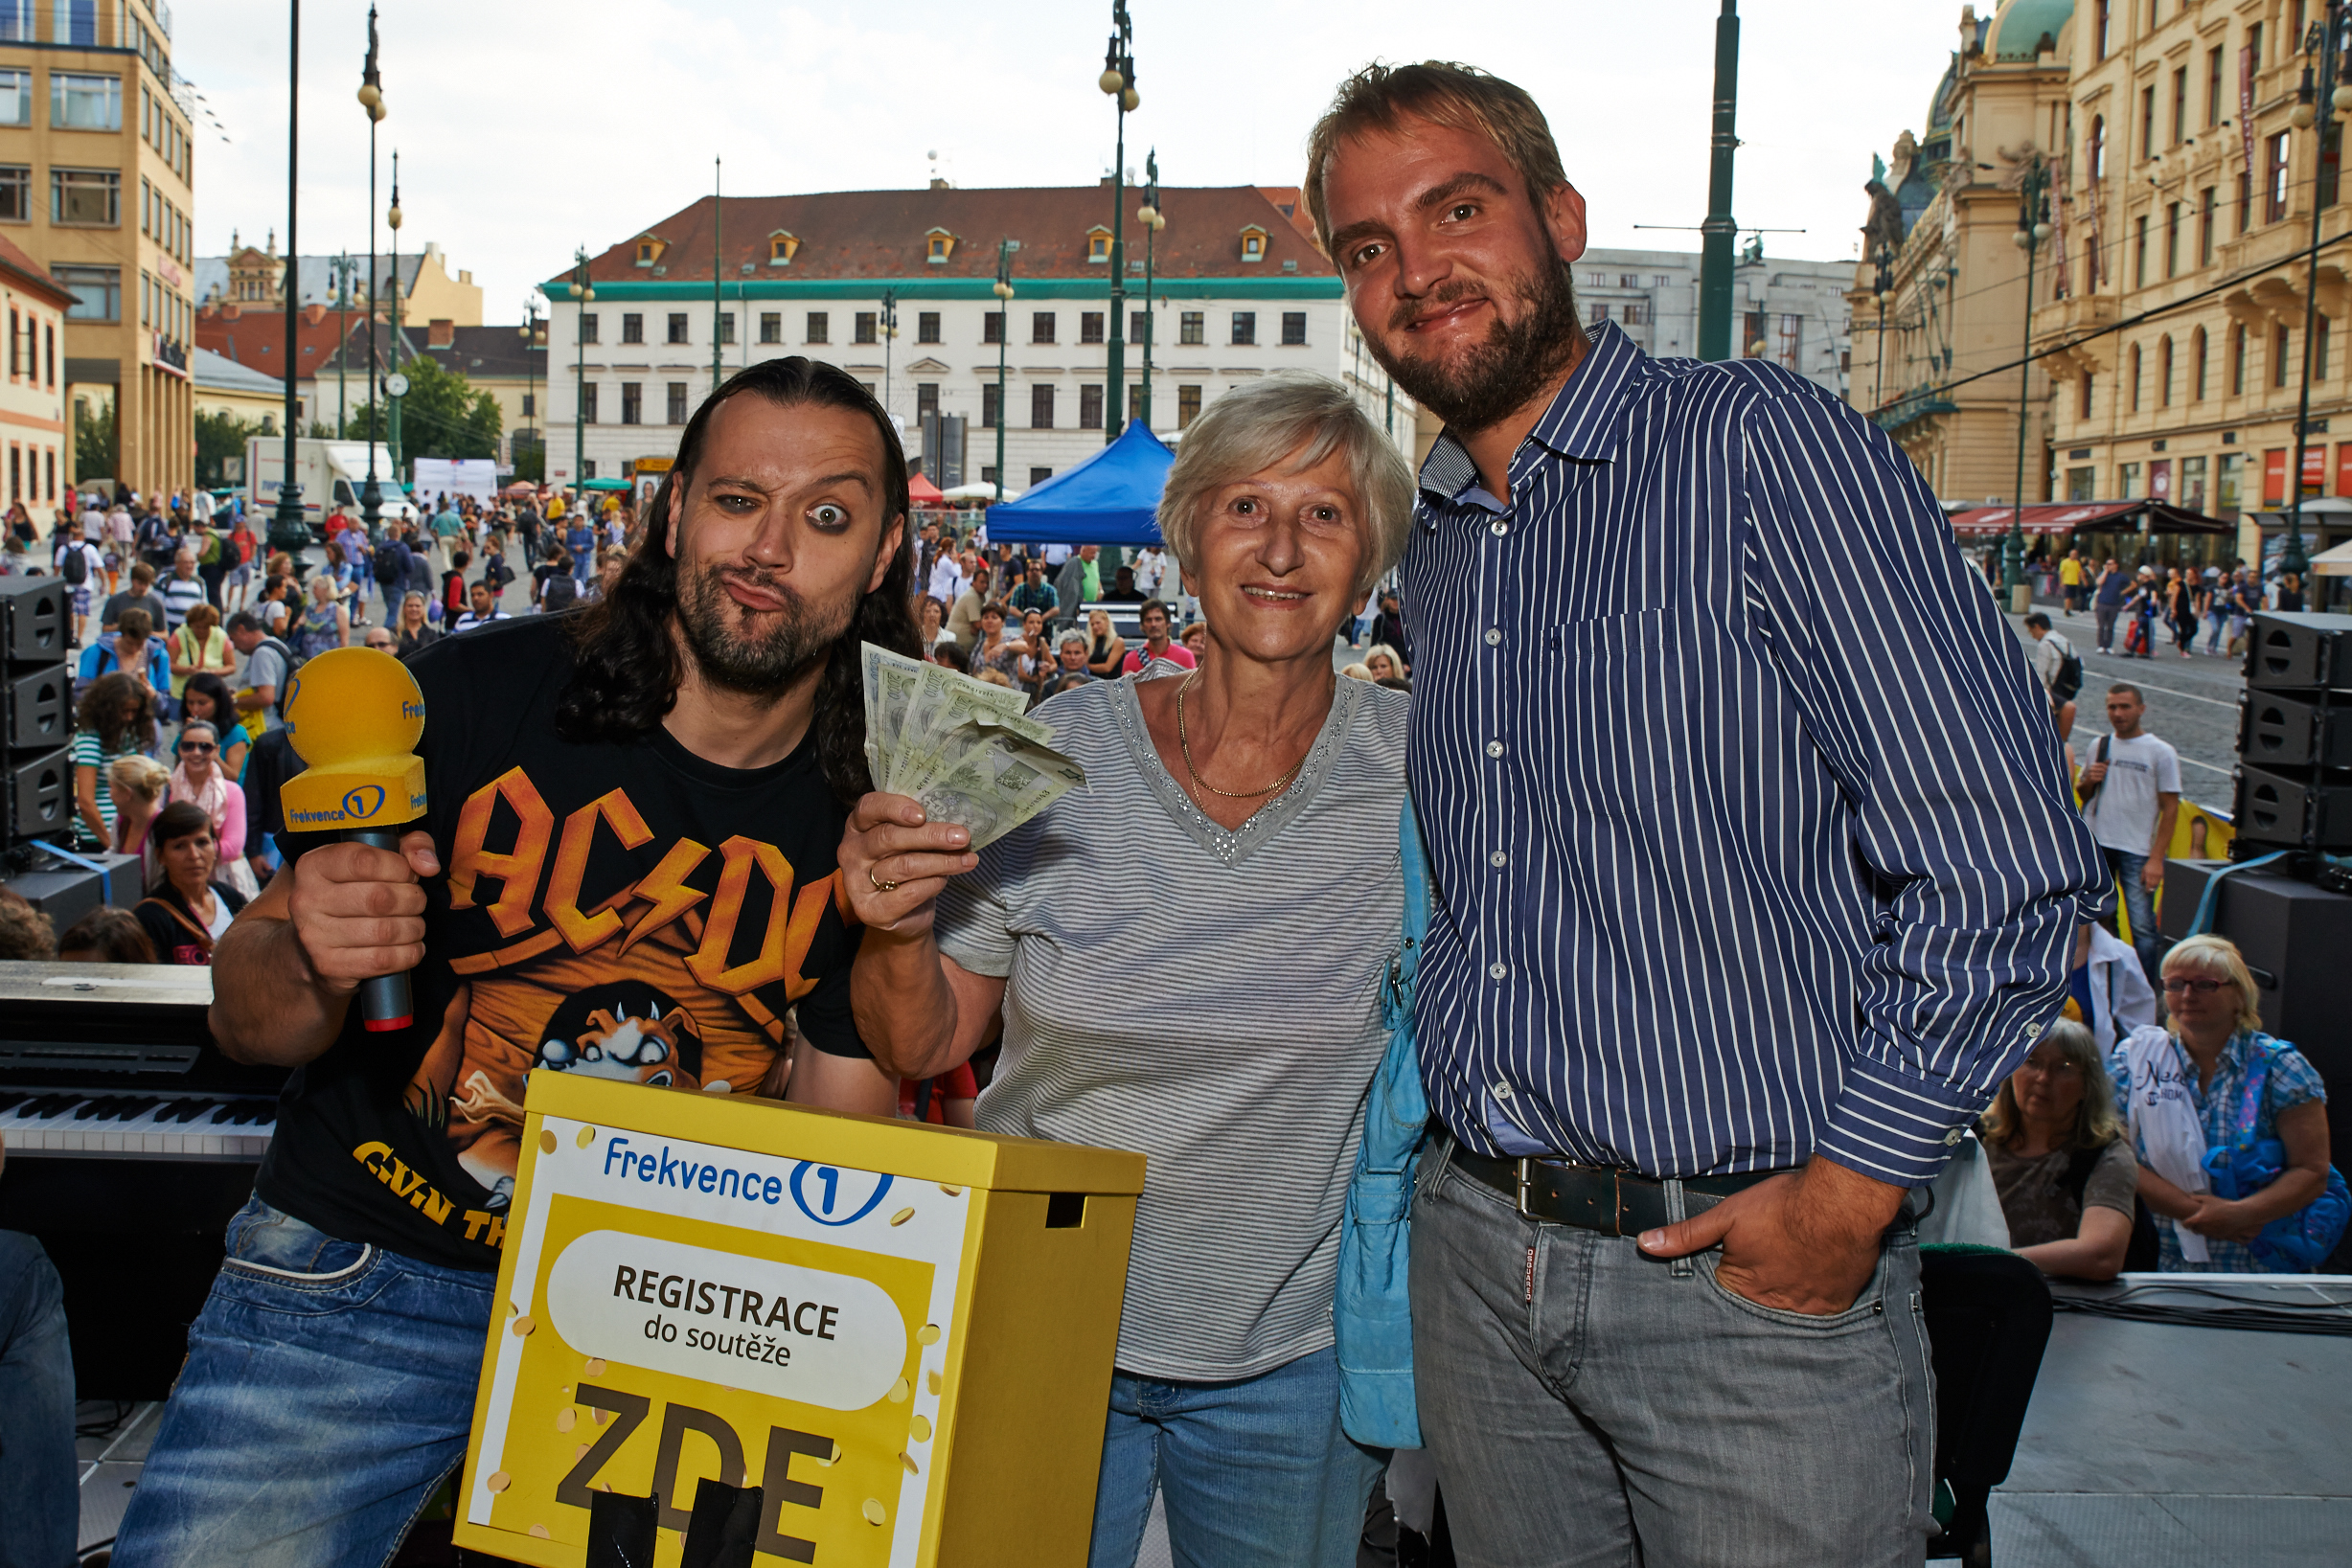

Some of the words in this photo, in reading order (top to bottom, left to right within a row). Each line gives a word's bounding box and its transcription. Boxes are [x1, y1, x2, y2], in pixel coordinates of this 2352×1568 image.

[887, 671, 901, 700] 2000
[924, 670, 945, 698] 2000
[948, 695, 973, 719] 2000
[290, 808, 346, 824] Frekvence
[604, 1136, 783, 1205] Frekvence
[1525, 1248, 1534, 1301] DSQUARED
[613, 1264, 840, 1341] REGISTRACE
[644, 1314, 677, 1343] do
[685, 1327, 791, 1367] soutěže
[555, 1382, 834, 1565] ZDE
